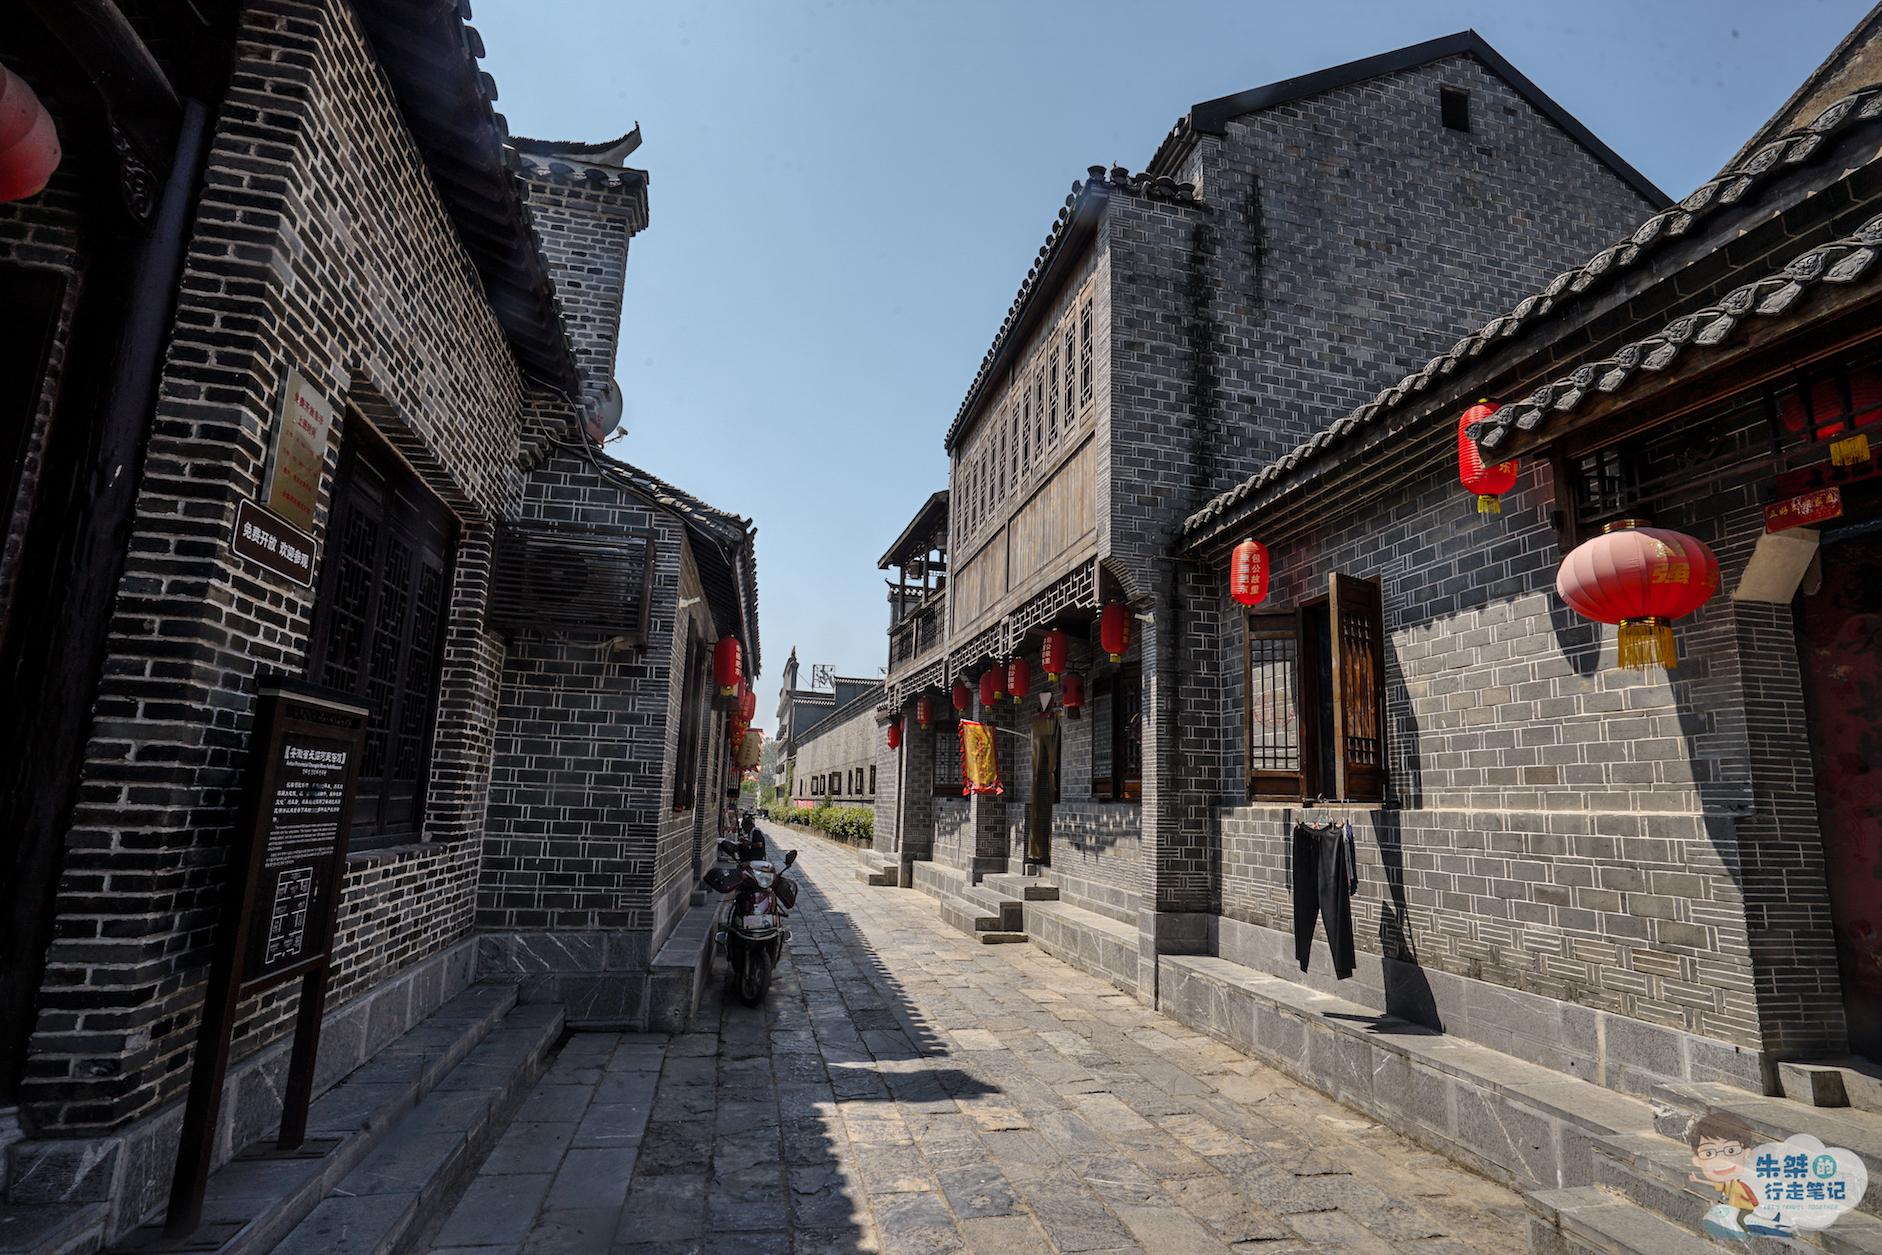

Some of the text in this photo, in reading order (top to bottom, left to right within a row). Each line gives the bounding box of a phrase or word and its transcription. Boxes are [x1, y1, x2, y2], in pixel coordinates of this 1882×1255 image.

[242, 521, 310, 571] 免费开放 欢迎参观
[1250, 553, 1261, 595] 包公故里
